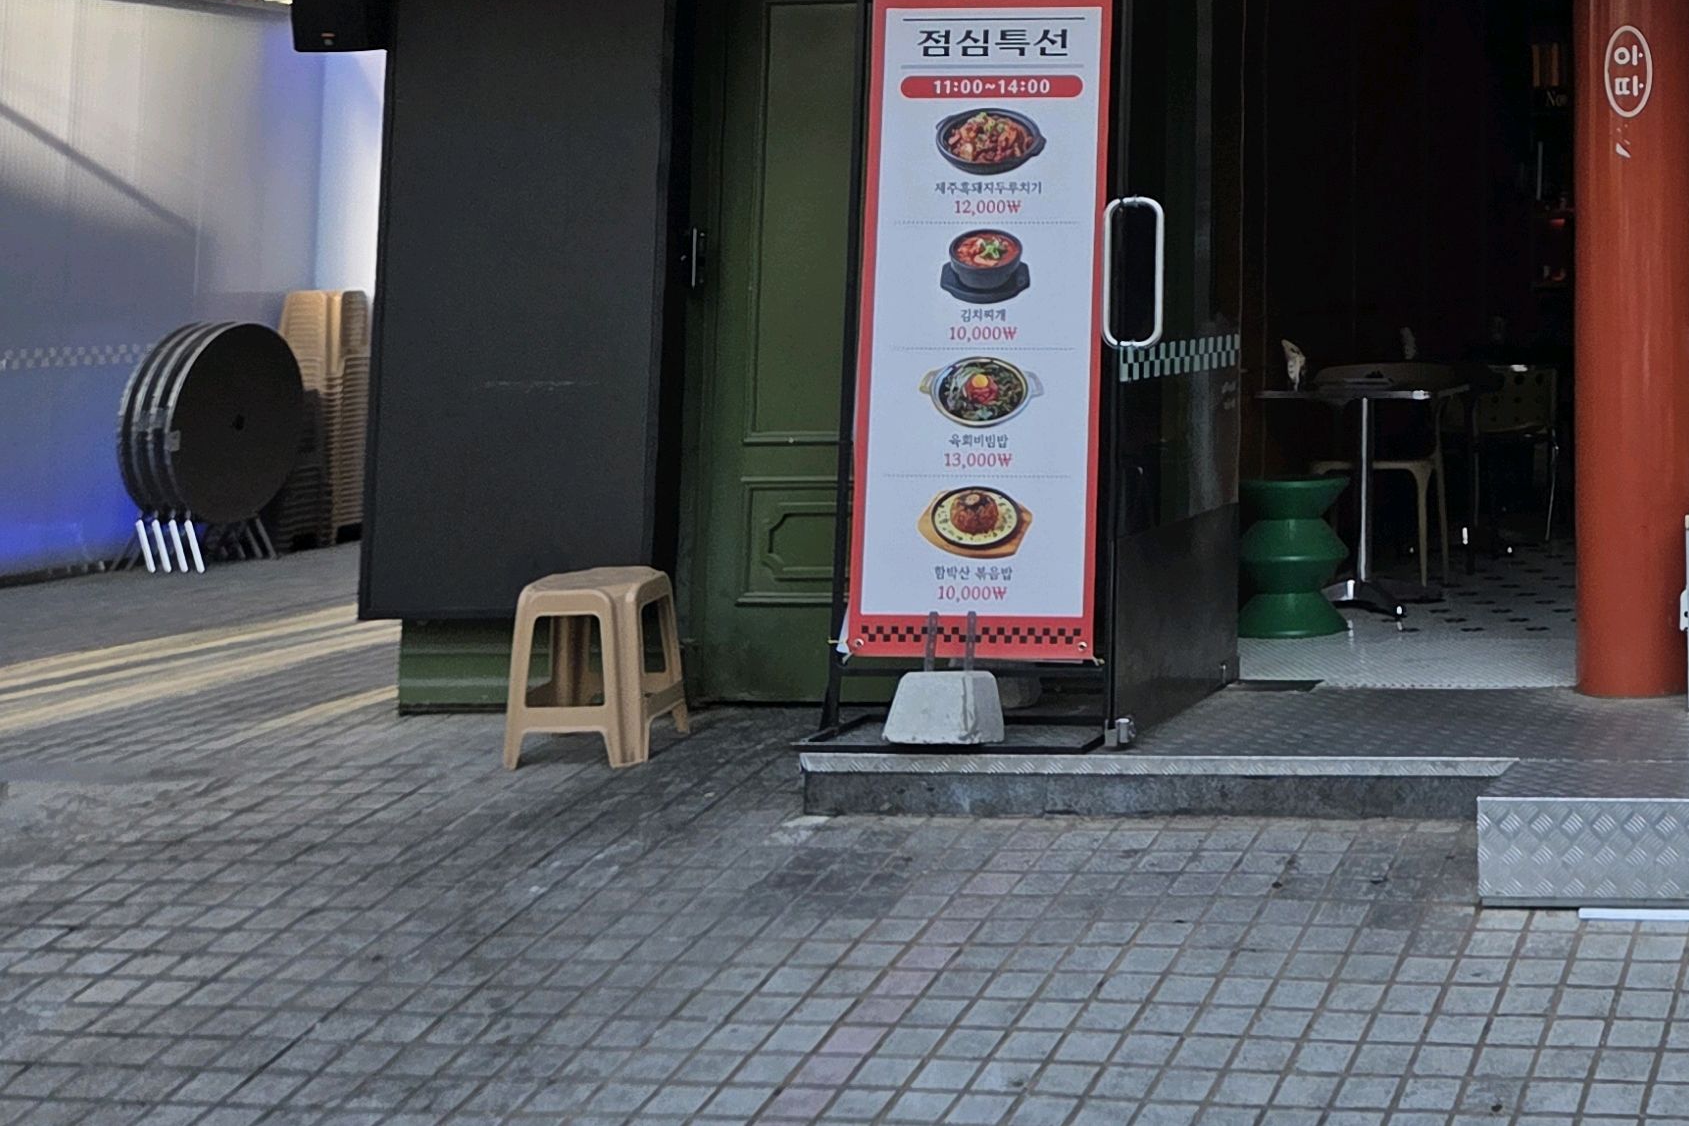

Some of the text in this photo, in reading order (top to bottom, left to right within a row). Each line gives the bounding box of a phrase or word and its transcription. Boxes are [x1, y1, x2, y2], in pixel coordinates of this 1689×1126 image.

[916, 28, 1069, 58] 점심특선
[933, 79, 1051, 95] 11:00~14:00
[960, 308, 1007, 323] 김치찌개
[948, 433, 1009, 449] 육회비빔밥
[974, 565, 1014, 582] 볶음밥
